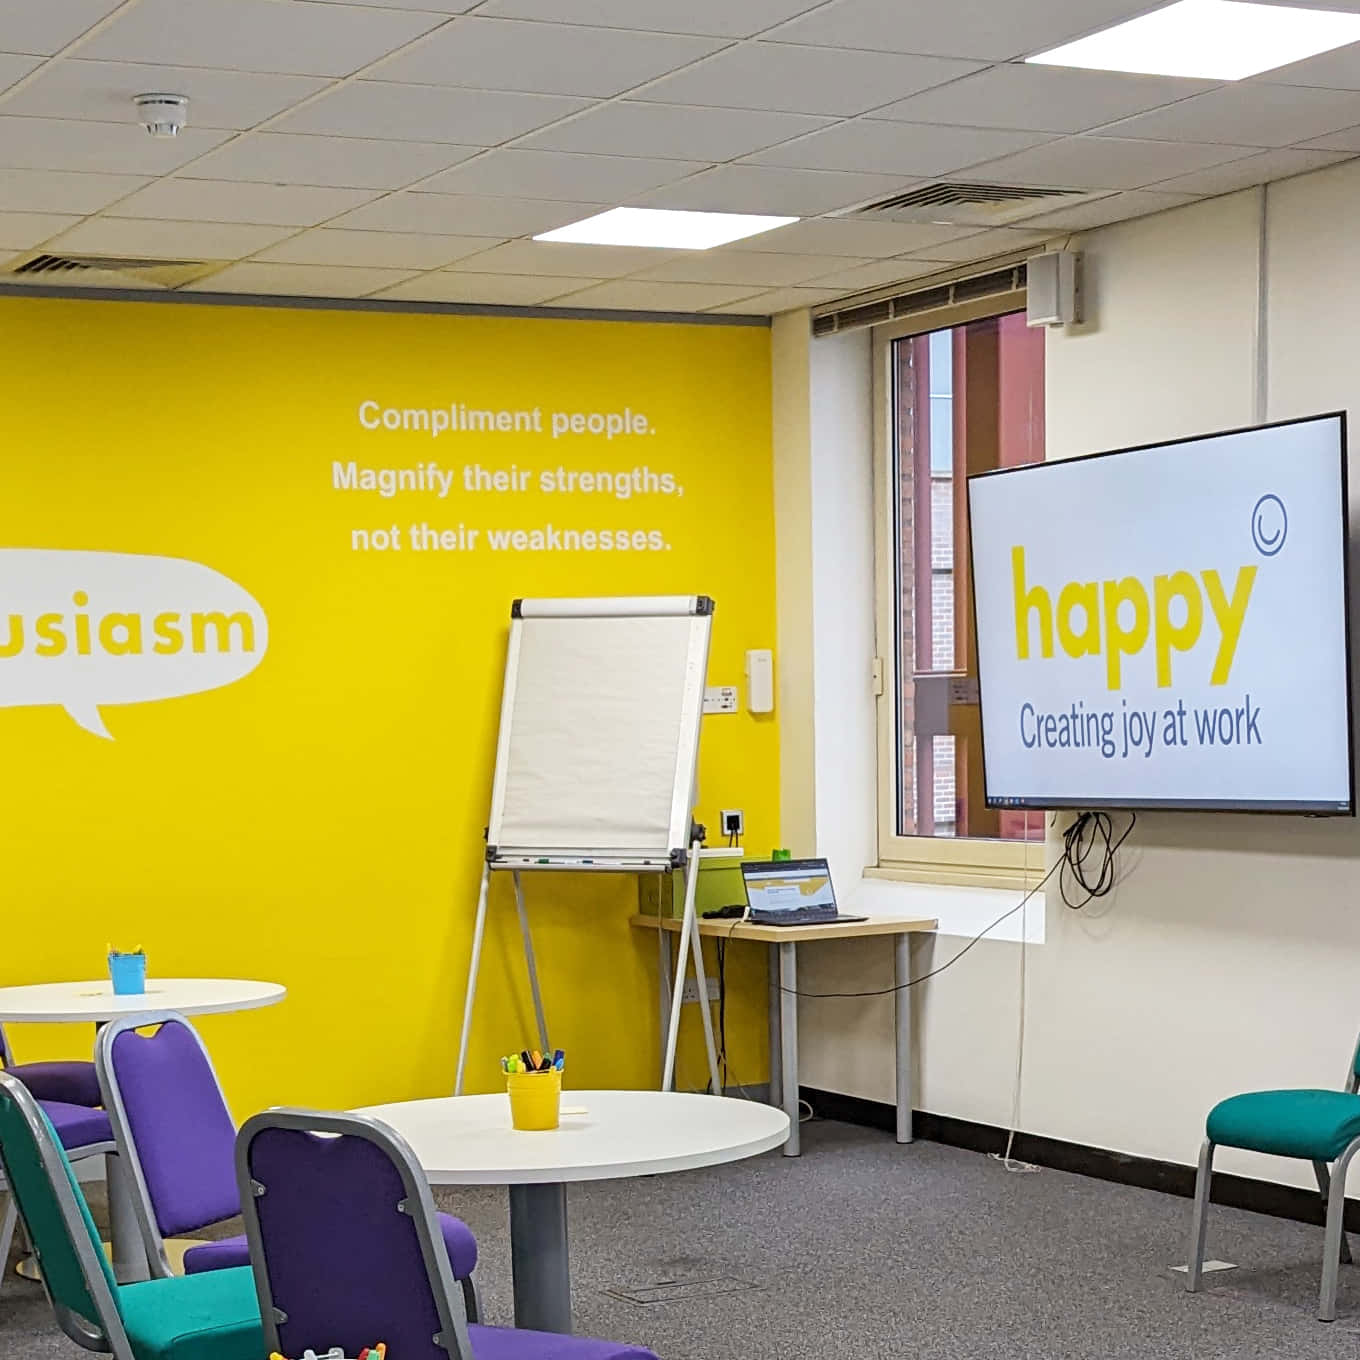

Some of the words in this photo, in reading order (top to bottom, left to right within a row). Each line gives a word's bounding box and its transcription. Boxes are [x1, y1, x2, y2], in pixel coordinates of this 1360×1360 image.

[358, 401, 543, 437] Compliment
[552, 408, 657, 439] people.
[332, 462, 453, 497] Magnify
[463, 465, 530, 492] their
[539, 466, 684, 498] strengths,
[351, 527, 401, 551] not
[409, 523, 479, 551] their
[488, 524, 672, 551] weaknesses.
[1011, 545, 1258, 691] happy
[1020, 701, 1115, 759] Creating
[1121, 700, 1157, 758] joy
[1163, 700, 1188, 746] at
[1194, 694, 1263, 745] work
